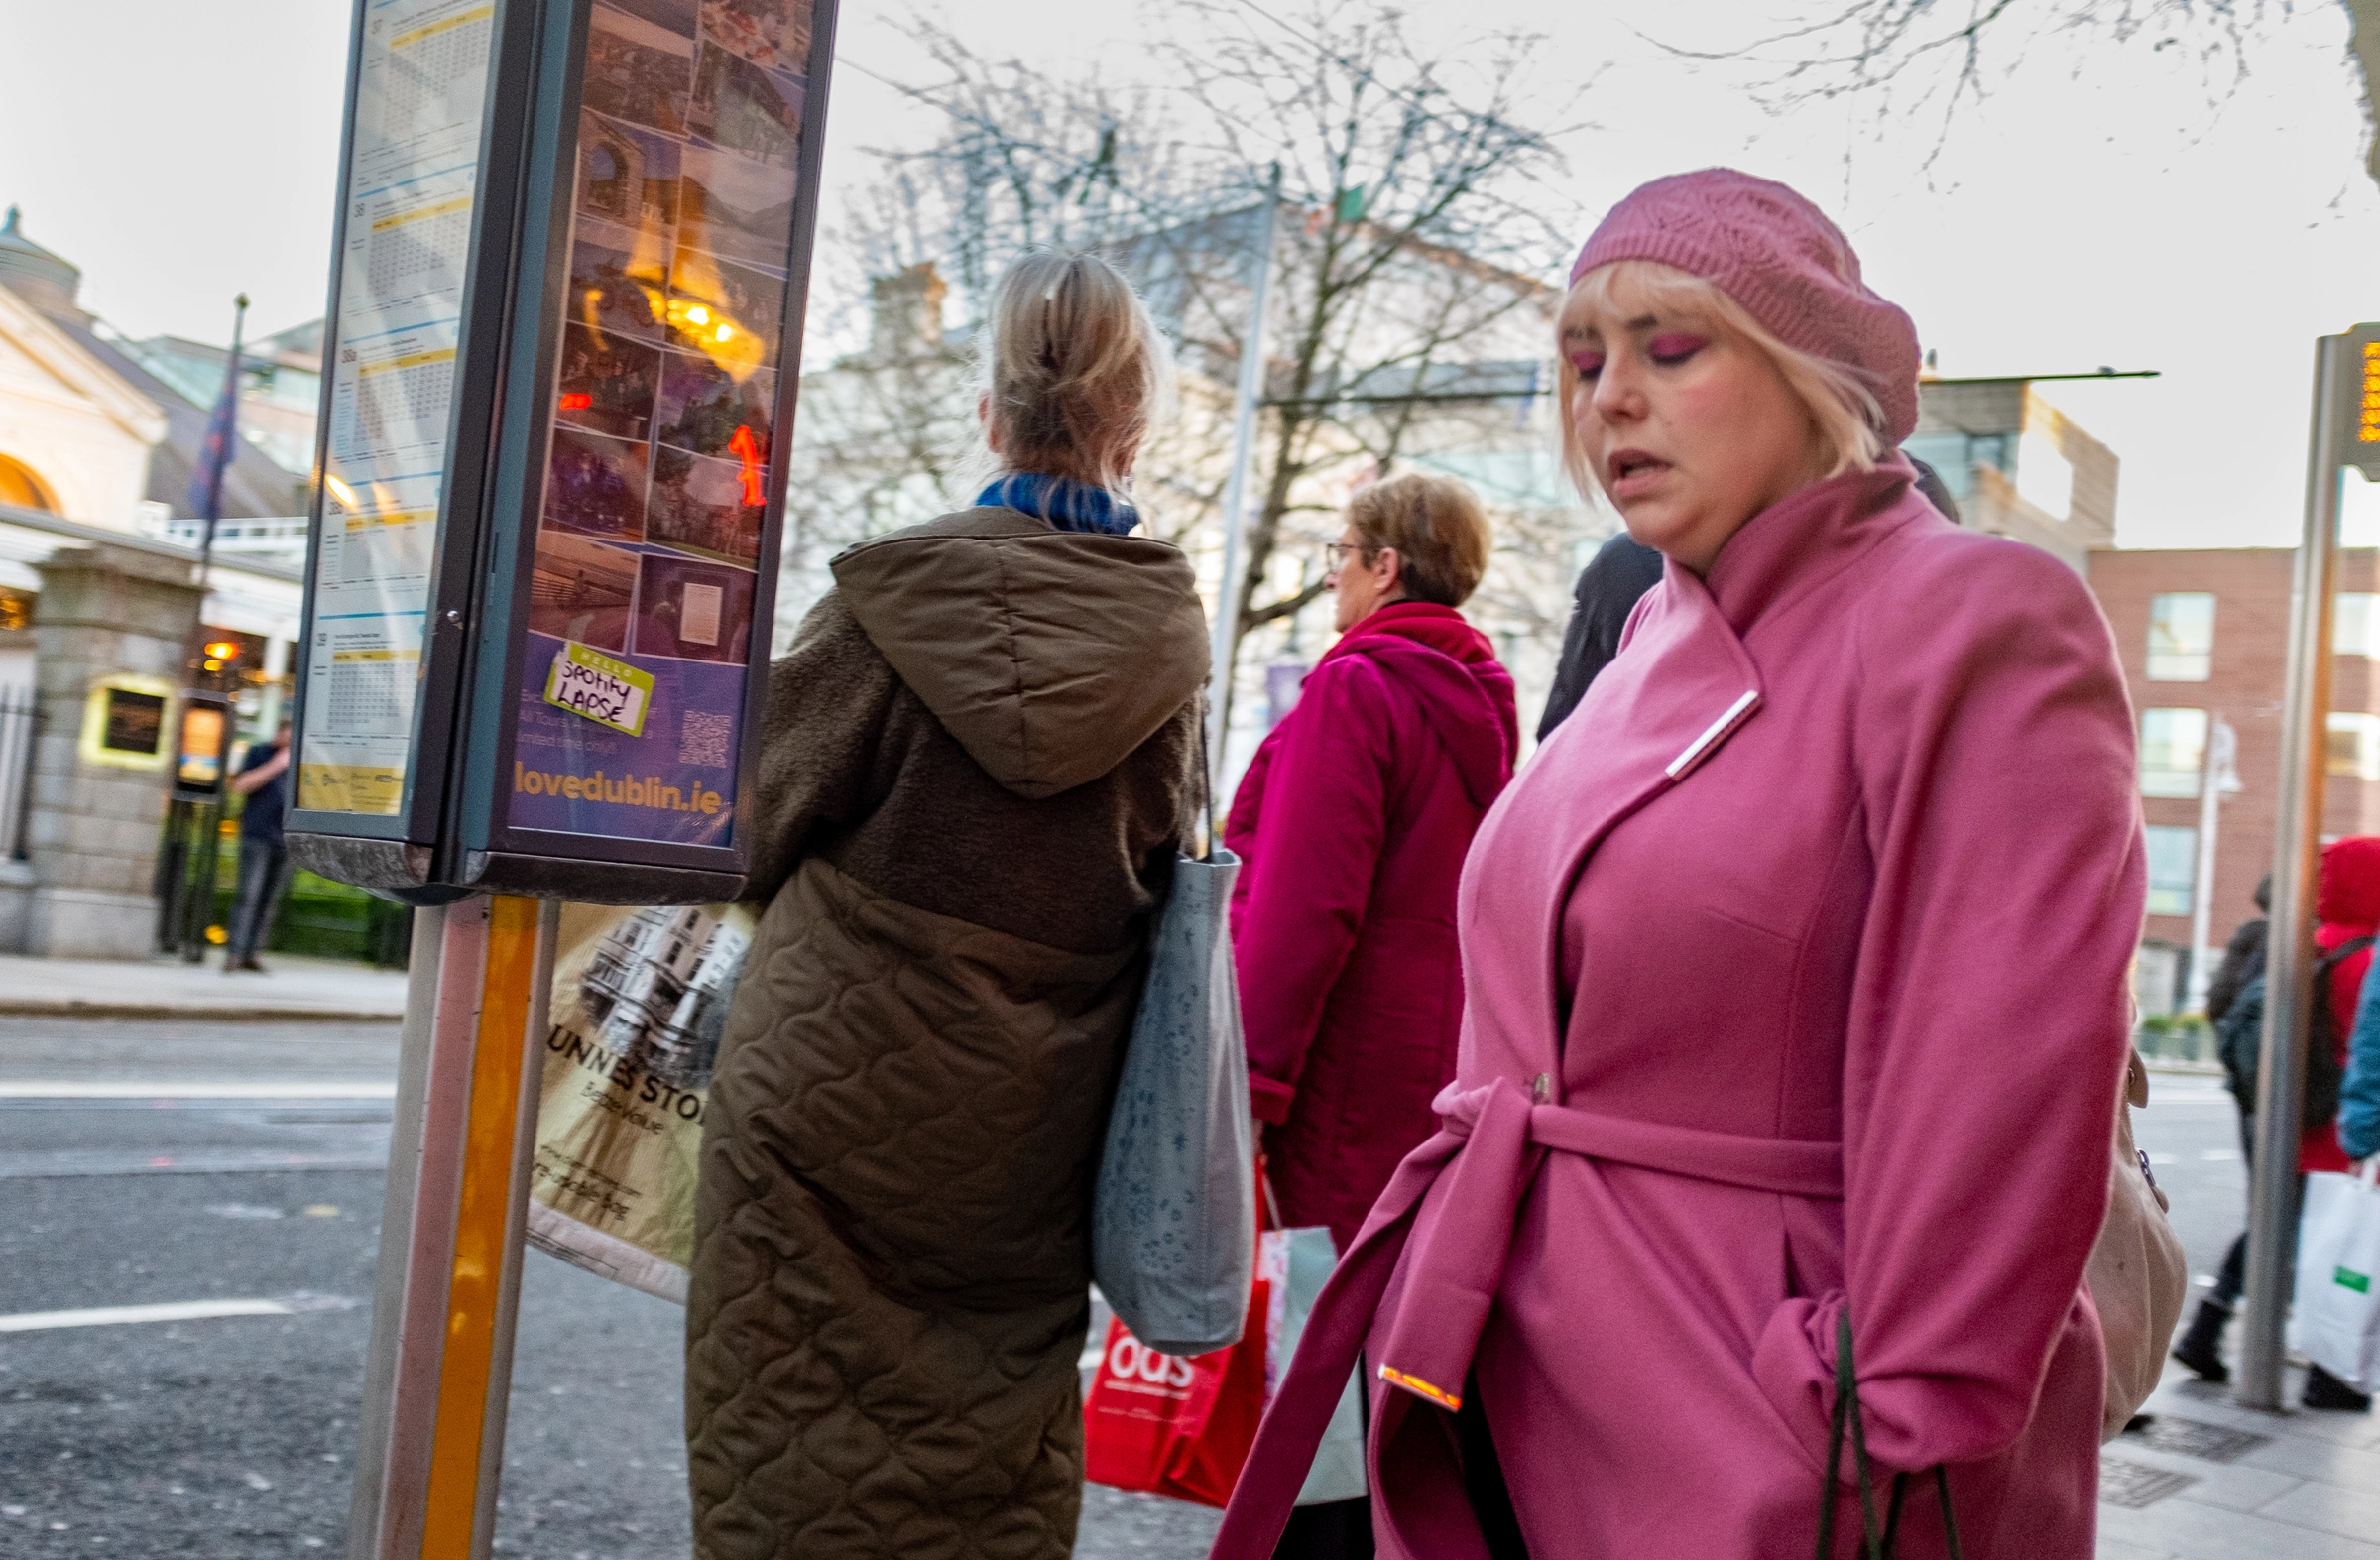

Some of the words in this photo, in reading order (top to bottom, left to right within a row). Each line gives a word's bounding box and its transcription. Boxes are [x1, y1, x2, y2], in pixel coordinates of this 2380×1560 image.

[557, 681, 625, 723] LAPSE
[514, 761, 722, 814] lovedublin.ie
[640, 1074, 705, 1128] STO
